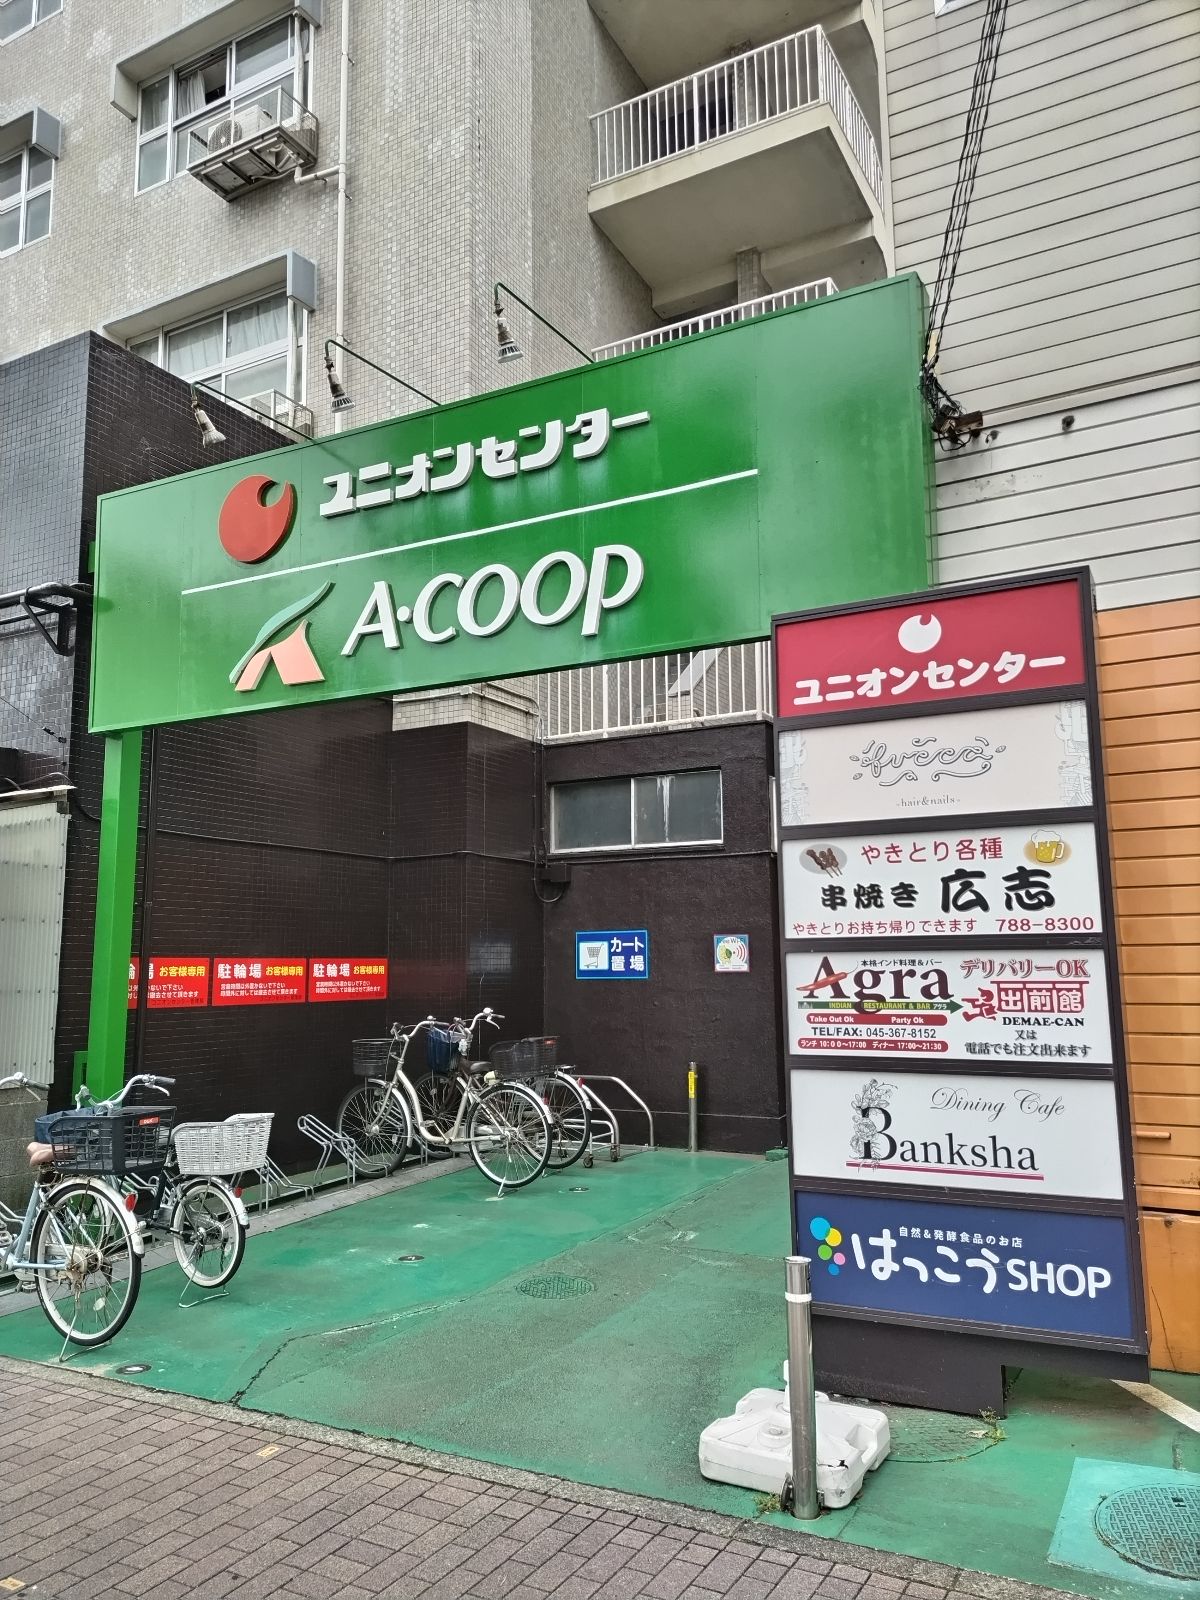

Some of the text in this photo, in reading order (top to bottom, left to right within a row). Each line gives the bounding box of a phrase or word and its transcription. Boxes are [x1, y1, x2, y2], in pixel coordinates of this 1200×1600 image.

[319, 406, 651, 518] ユニオンセンター
[793, 651, 1066, 706] ユニオンセンター
[860, 836, 1004, 865] やきとり各種
[792, 916, 1095, 936] やきとりお持ち帰りできます 788-8300
[610, 936, 645, 953] カート
[159, 965, 206, 977] お客様専用
[217, 963, 304, 979] 駐輪場 お客様専用
[313, 963, 385, 978] 駐輪場 お客様専用
[611, 955, 645, 972] 置場
[960, 957, 1091, 979] デリバリーOK
[802, 956, 954, 1015] Agra
[863, 1002, 906, 1010] RESTAURANT
[1000, 989, 1082, 1012] 出前館
[809, 1015, 828, 1023] Take
[828, 1015, 842, 1023] Out
[891, 1016, 911, 1025] Party
[1002, 1017, 1085, 1027] DEMAE-CAN
[811, 1027, 937, 1039] TEL/FAX: 045-367-8152
[1014, 1029, 1038, 1041] 又は
[800, 1040, 817, 1048] ランチ
[964, 1041, 1092, 1057] 電話でも注文出来ます
[930, 1087, 1065, 1122] Dining Cafe
[855, 1105, 1039, 1171] Banksha
[899, 1226, 1024, 1249] 自然&発酵食品のお店
